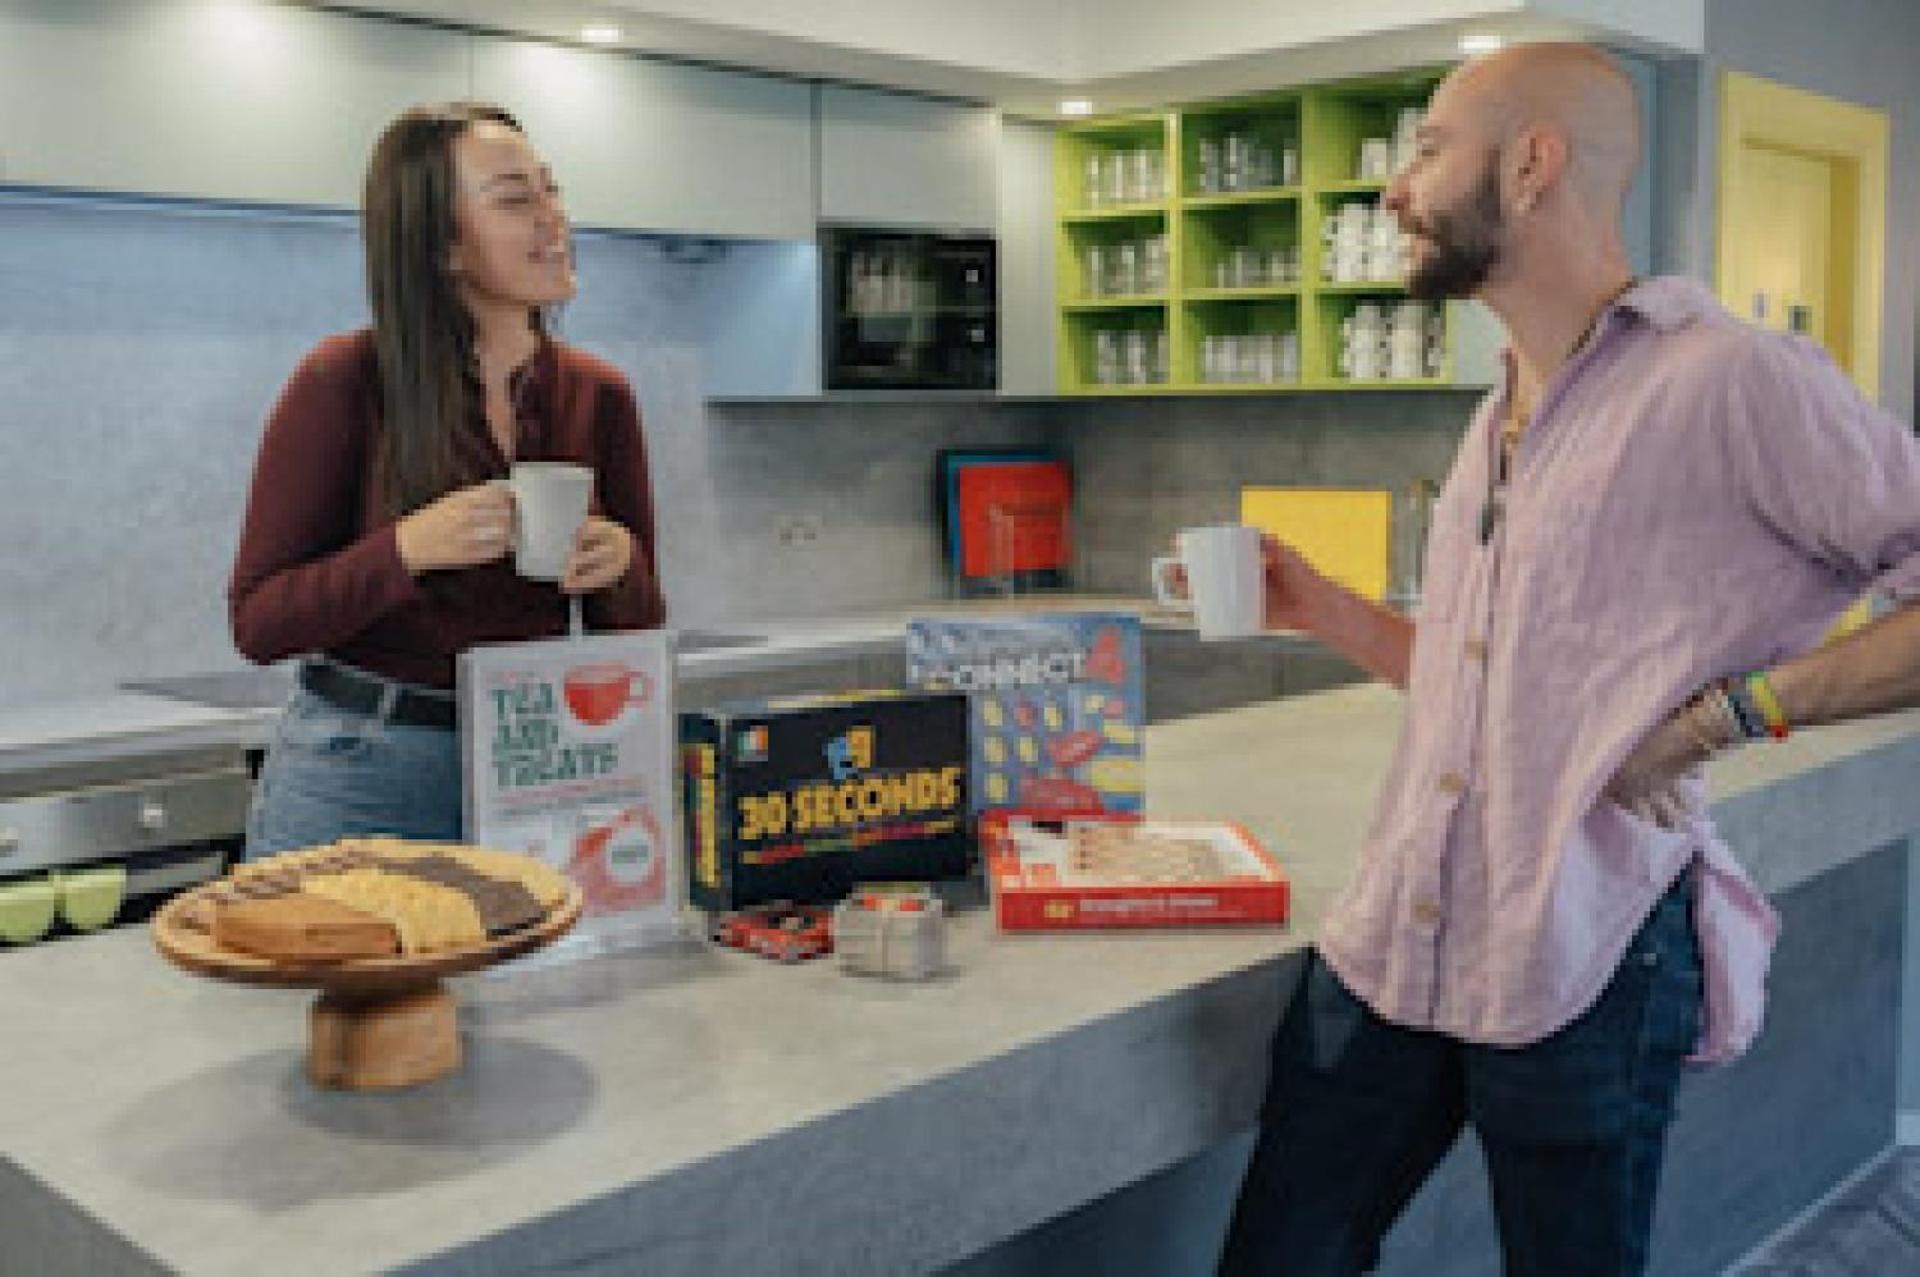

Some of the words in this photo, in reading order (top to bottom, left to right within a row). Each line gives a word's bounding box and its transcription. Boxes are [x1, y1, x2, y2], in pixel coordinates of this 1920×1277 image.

[492, 682, 555, 719] TEA
[492, 717, 560, 751] AND
[737, 790, 786, 840] 30
[793, 766, 961, 830] SECONDS
